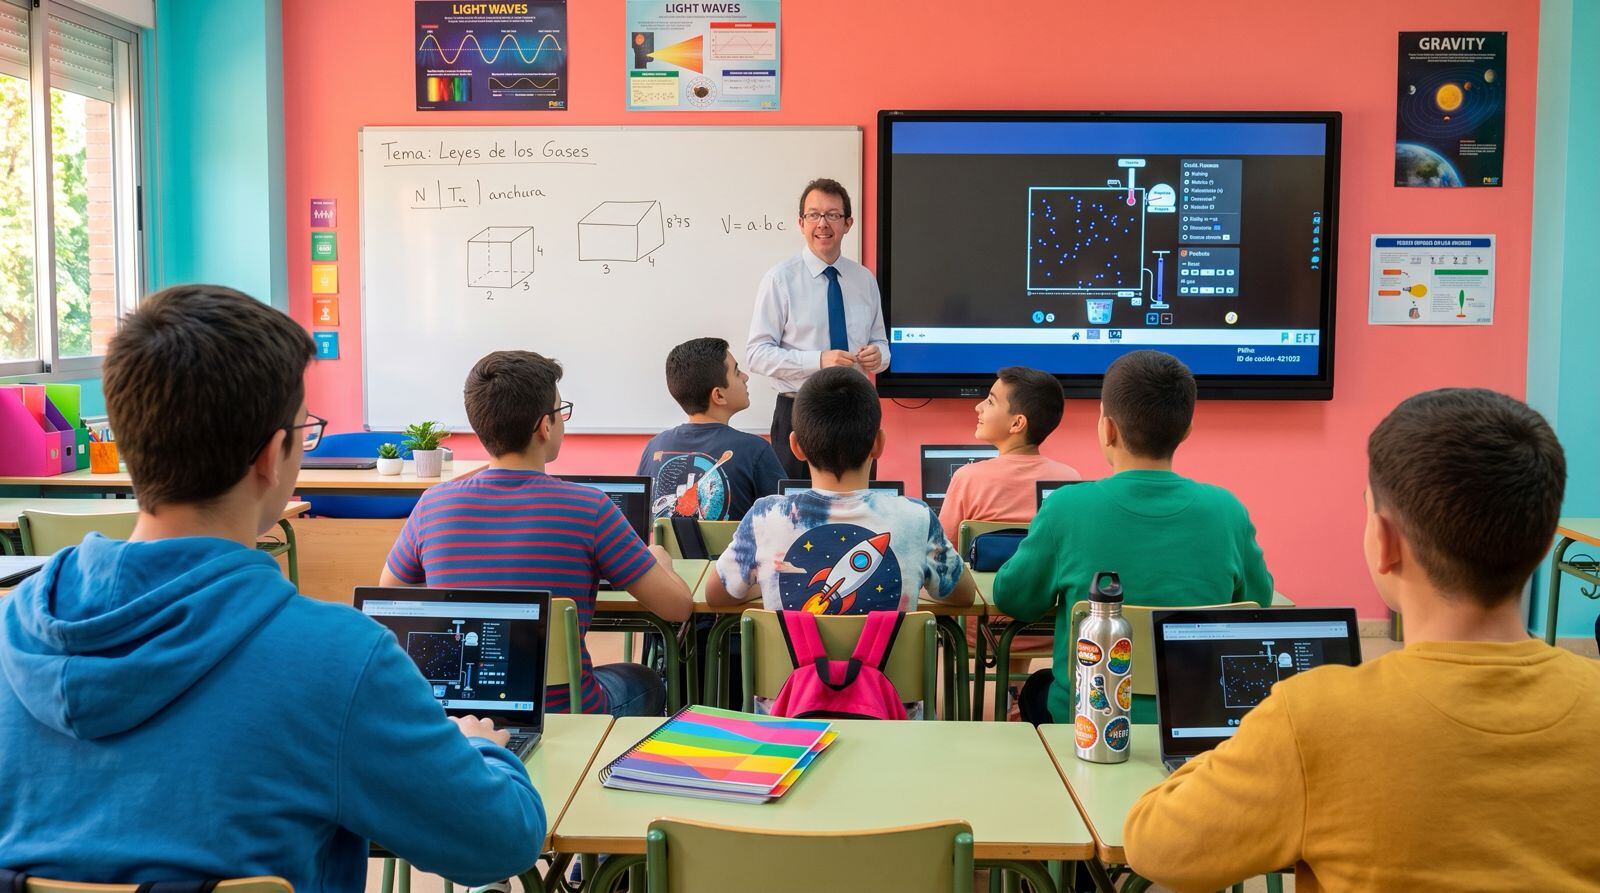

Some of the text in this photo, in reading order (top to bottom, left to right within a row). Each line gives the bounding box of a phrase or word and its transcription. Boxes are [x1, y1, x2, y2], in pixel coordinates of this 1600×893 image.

[453, 4, 528, 14] LIGHT WAVES
[665, 3, 740, 13] LIGHT WAVES
[1419, 37, 1485, 50] GRAVITY
[381, 140, 589, 166] Tema: Leyes de los Gases
[415, 187, 426, 202] N
[489, 185, 546, 200] anchura
[537, 245, 544, 256] 4
[648, 256, 655, 267] 4
[602, 264, 611, 274] 3
[523, 281, 530, 291] 3
[486, 291, 494, 301] 2
[1296, 333, 1316, 343] EFT
